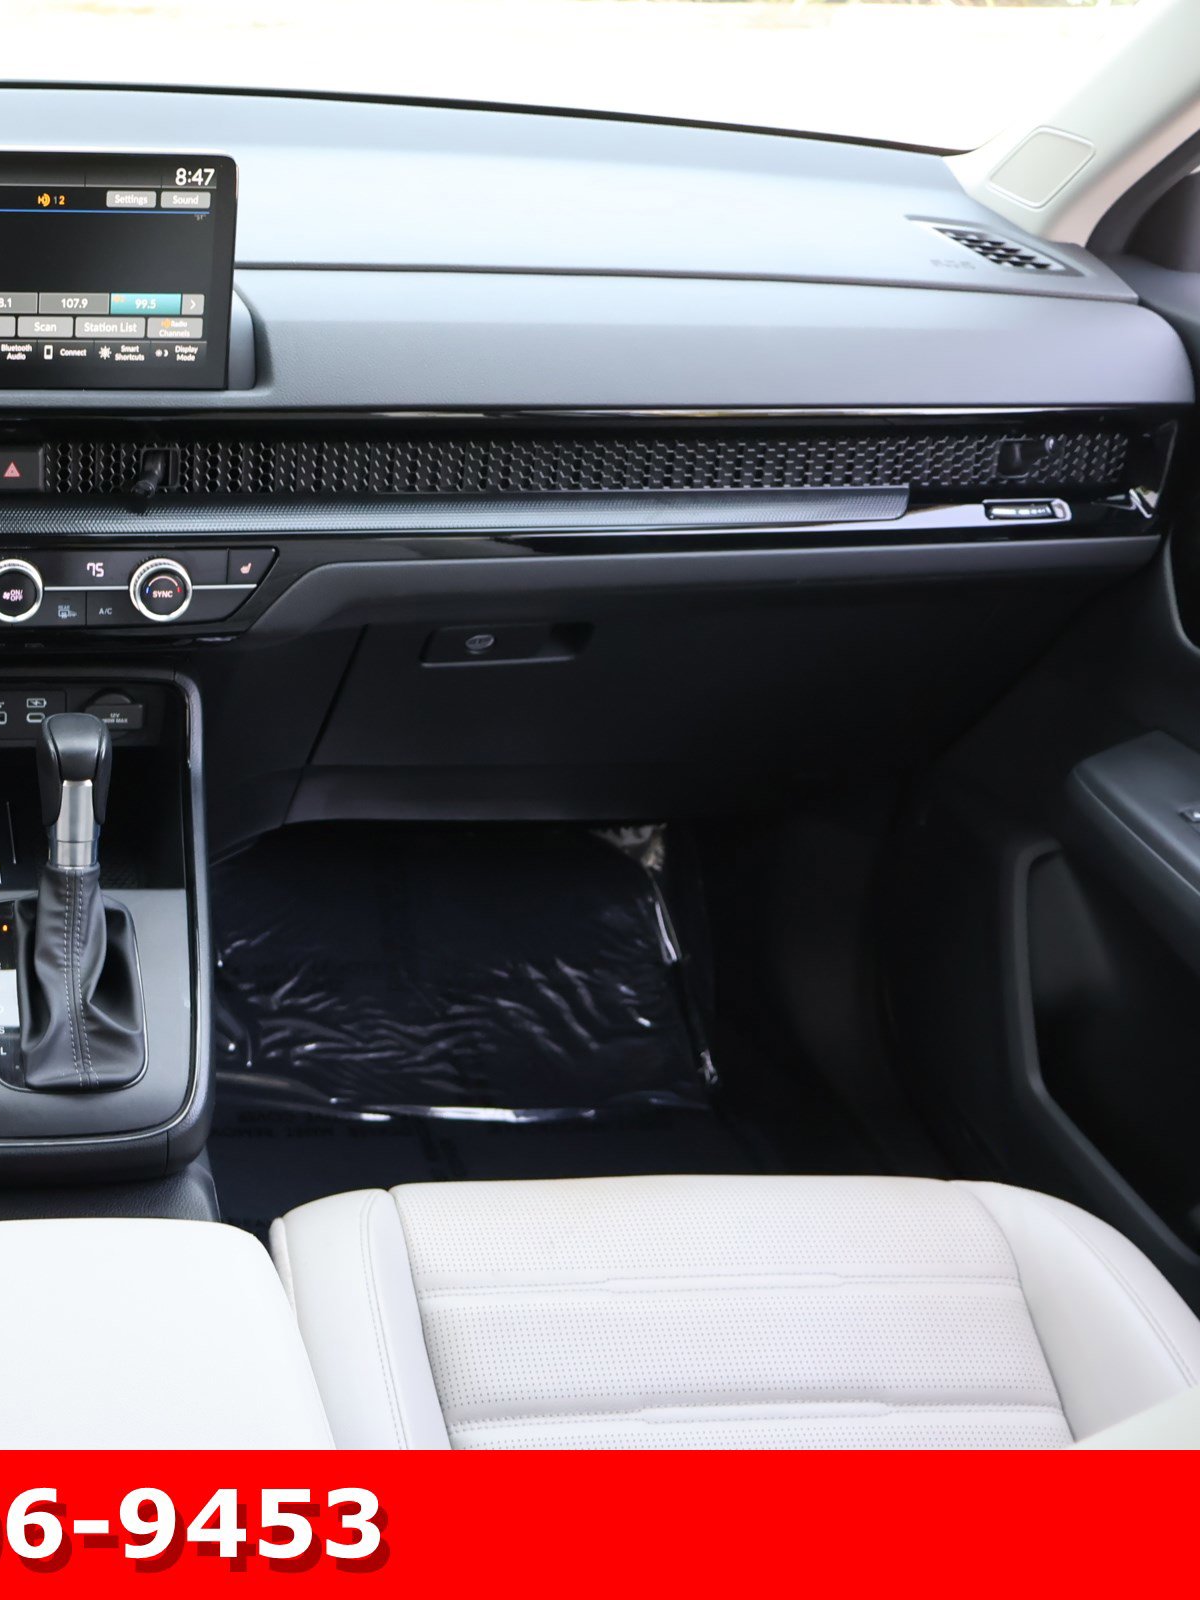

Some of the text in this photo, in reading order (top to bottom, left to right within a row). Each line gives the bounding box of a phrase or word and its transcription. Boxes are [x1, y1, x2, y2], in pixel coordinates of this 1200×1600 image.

[175, 168, 215, 186] 8:47
[59, 196, 65, 205] 2
[115, 195, 148, 205] Settings
[173, 195, 199, 204] Sound
[61, 298, 88, 309] 107.9
[135, 299, 156, 309] 99.5
[34, 322, 57, 332] Scan
[84, 322, 137, 333] Station List
[1, 344, 34, 352] Bluetooth
[121, 345, 139, 353] Smart
[175, 345, 198, 354] Display
[60, 349, 86, 357] Connect
[115, 353, 144, 361] Shortcuts
[86, 562, 104, 578] 75
[0, 1047, 7, 1055] L
